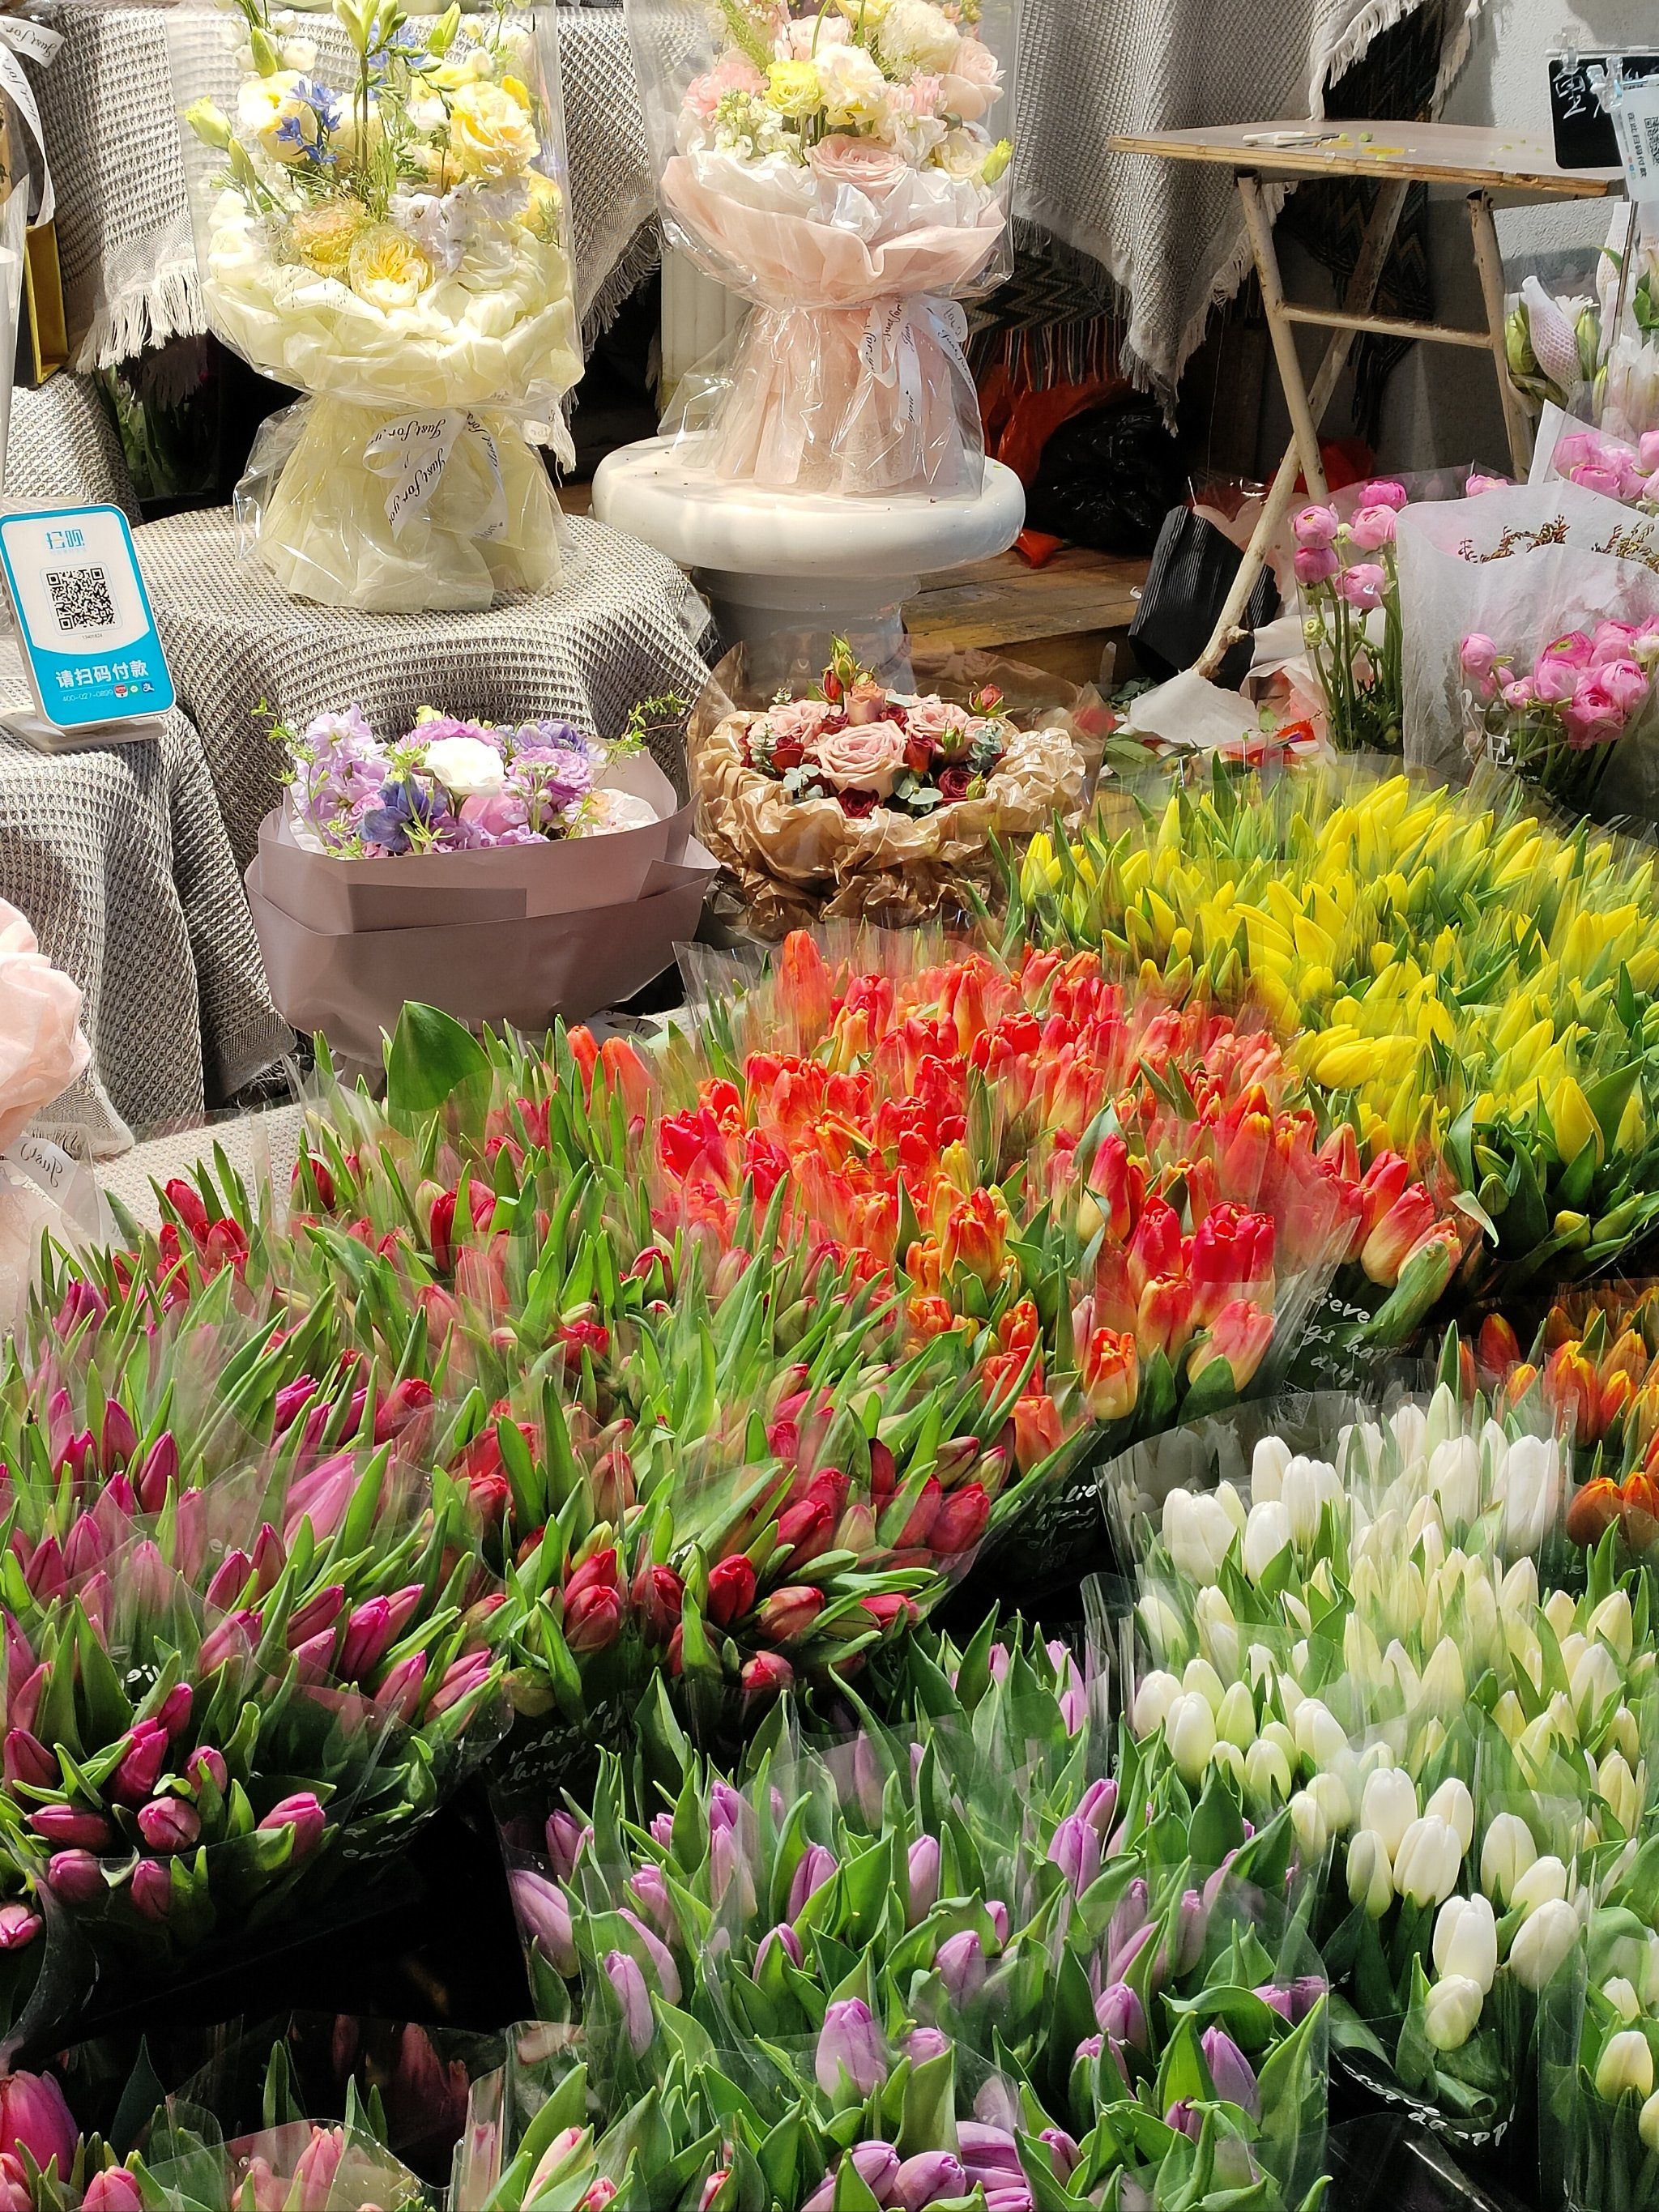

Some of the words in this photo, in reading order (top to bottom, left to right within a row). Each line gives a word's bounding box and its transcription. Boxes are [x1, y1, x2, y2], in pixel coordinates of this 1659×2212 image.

[388, 420, 419, 441] for
[416, 419, 446, 439] Just
[421, 447, 446, 483] Just
[403, 469, 423, 503] for
[55, 659, 149, 688] 请扫码付款
